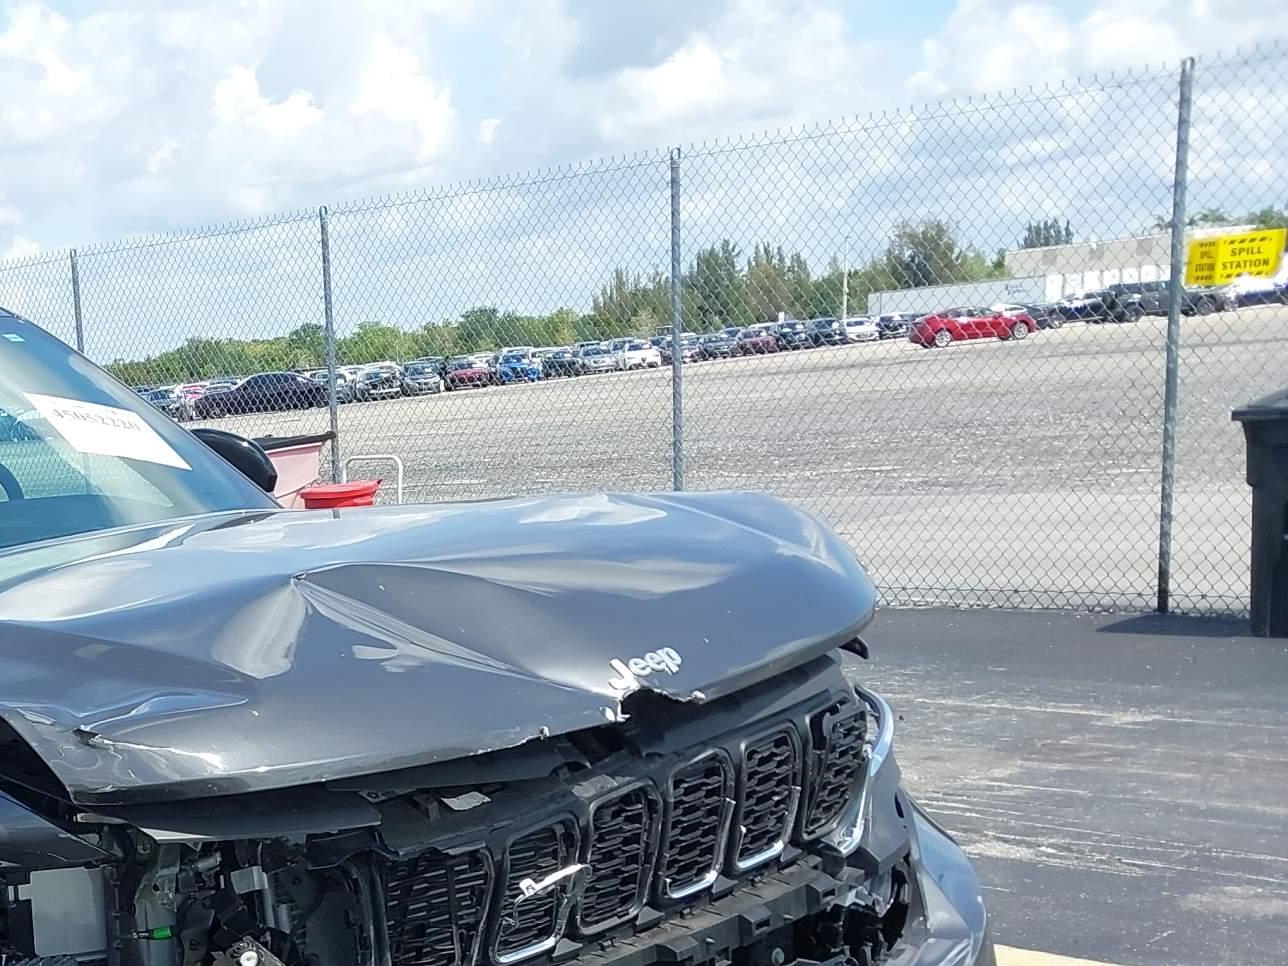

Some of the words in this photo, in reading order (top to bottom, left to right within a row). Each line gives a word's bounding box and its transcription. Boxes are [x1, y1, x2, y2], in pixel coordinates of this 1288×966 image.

[1230, 246, 1263, 257] SPILL
[1221, 258, 1270, 271] STATION
[608, 647, 682, 690] Jeep
